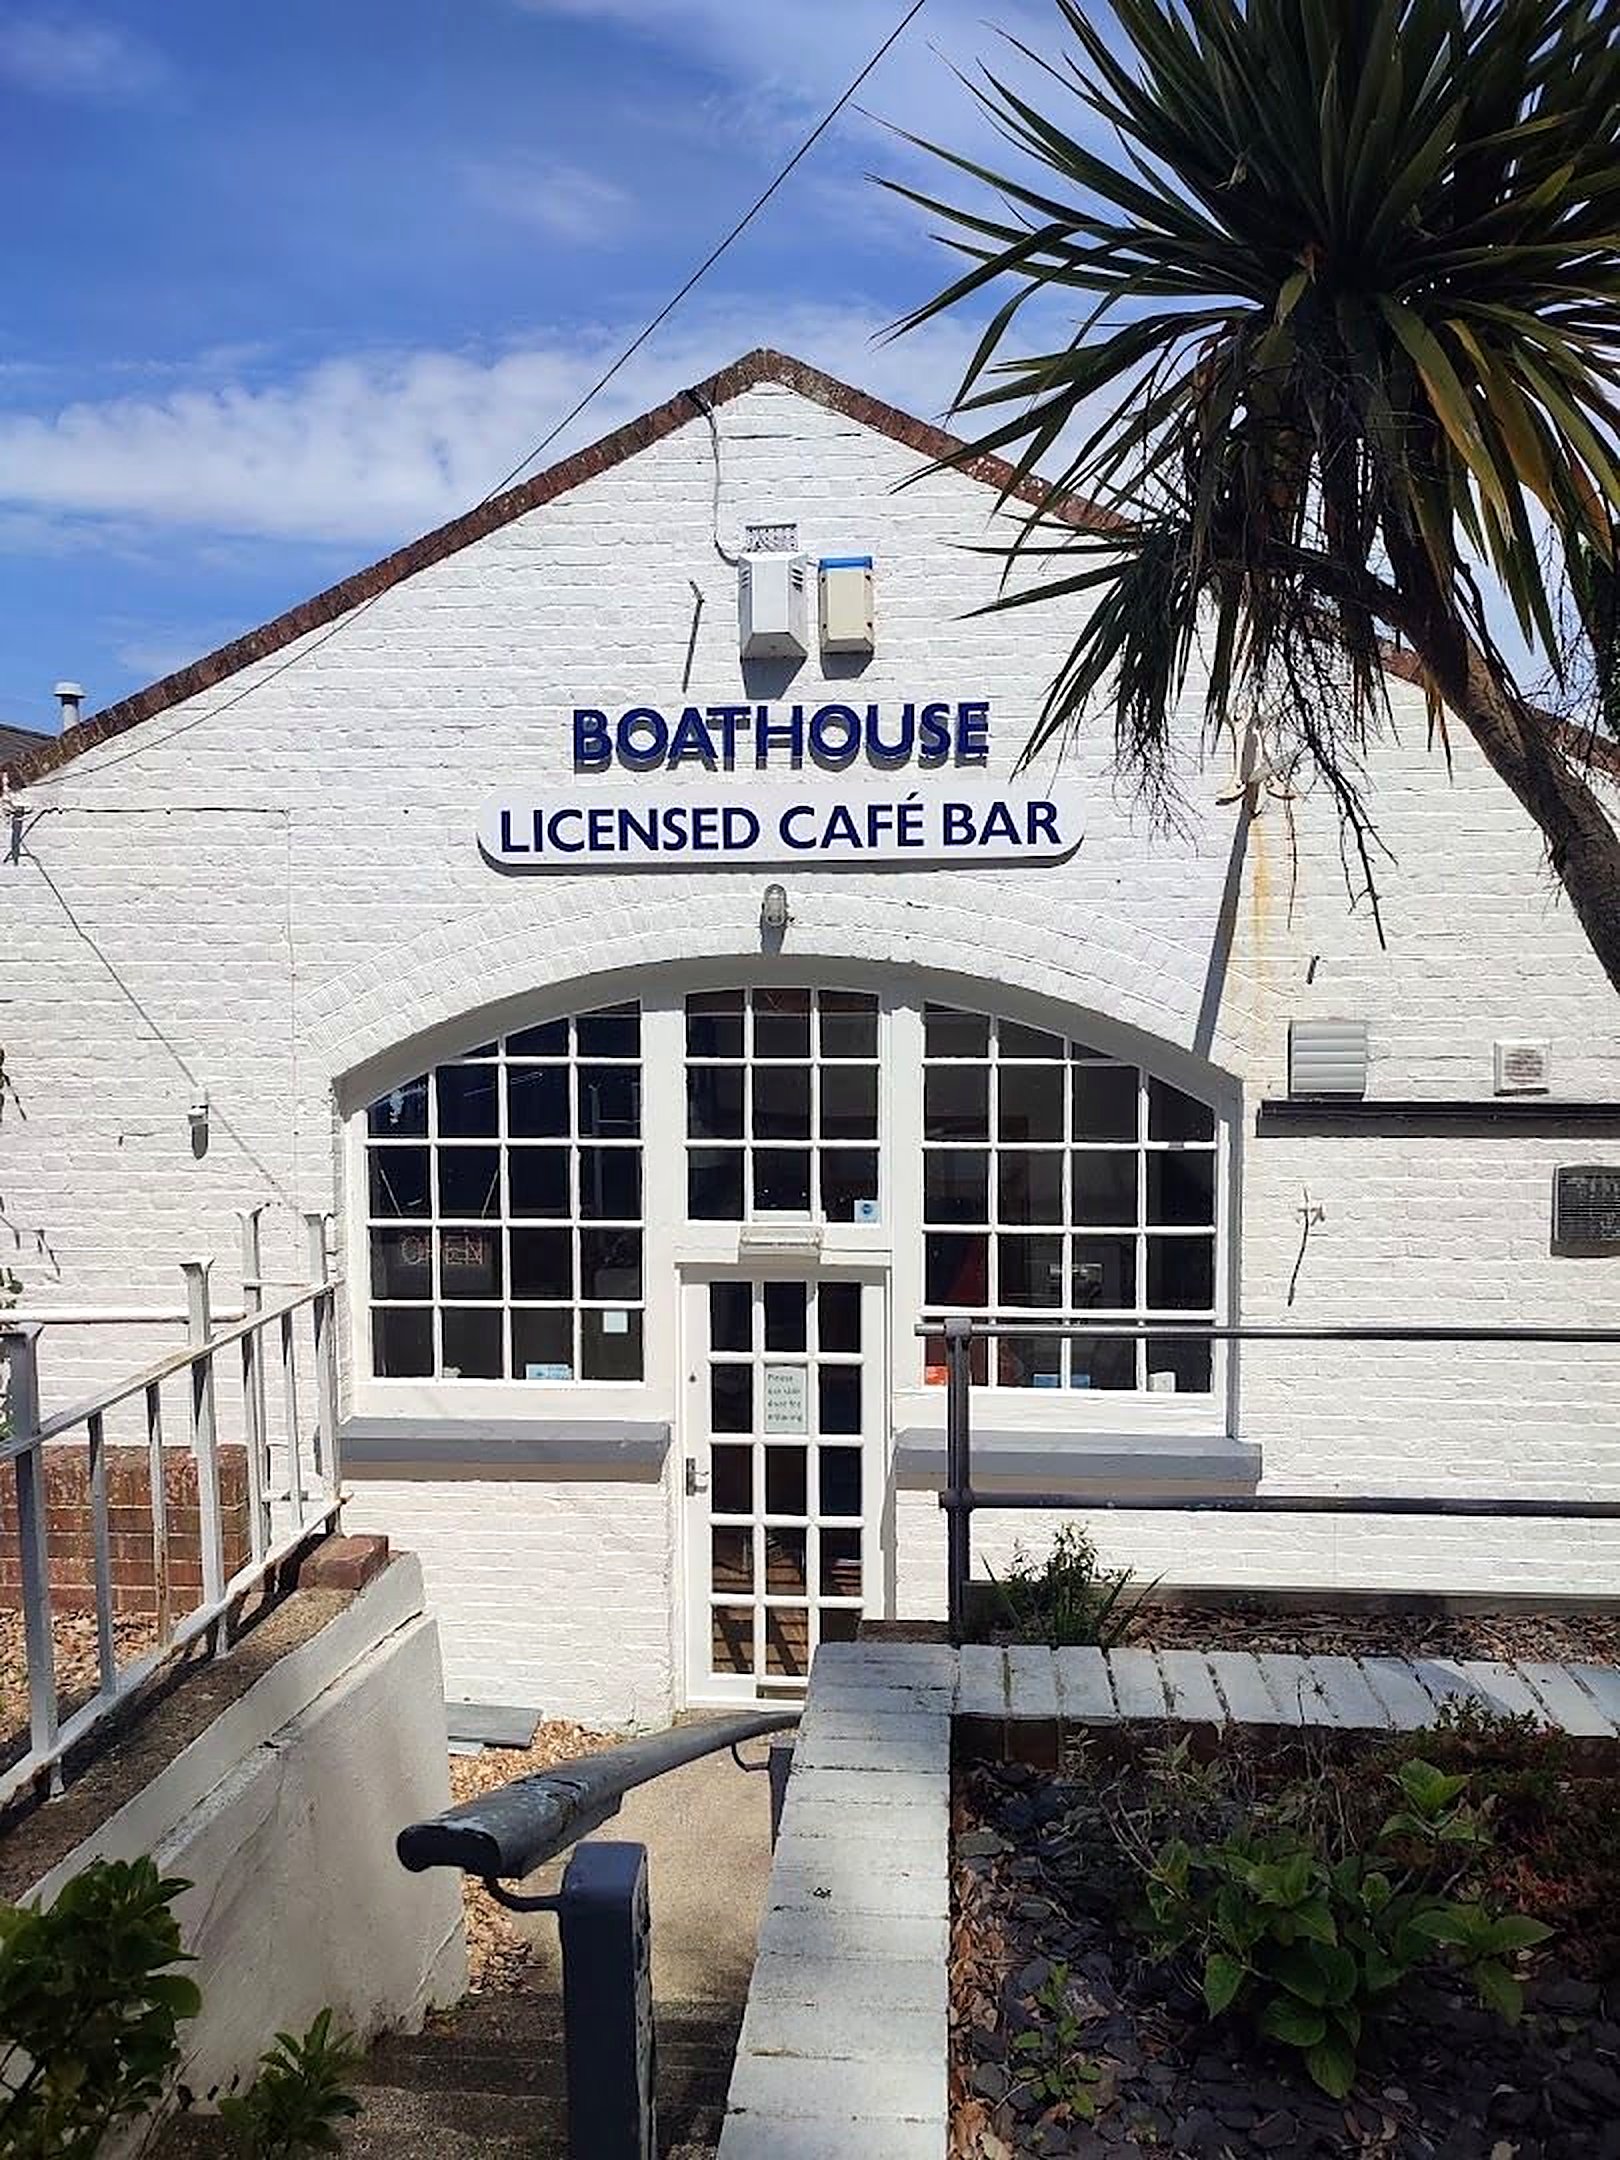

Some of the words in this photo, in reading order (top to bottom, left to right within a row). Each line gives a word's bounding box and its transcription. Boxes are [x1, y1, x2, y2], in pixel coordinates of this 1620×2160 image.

[573, 701, 990, 765] BOATHOUSE
[501, 808, 760, 853] LICENSED
[779, 791, 922, 848] CAFÉ
[942, 801, 1062, 845] BAR
